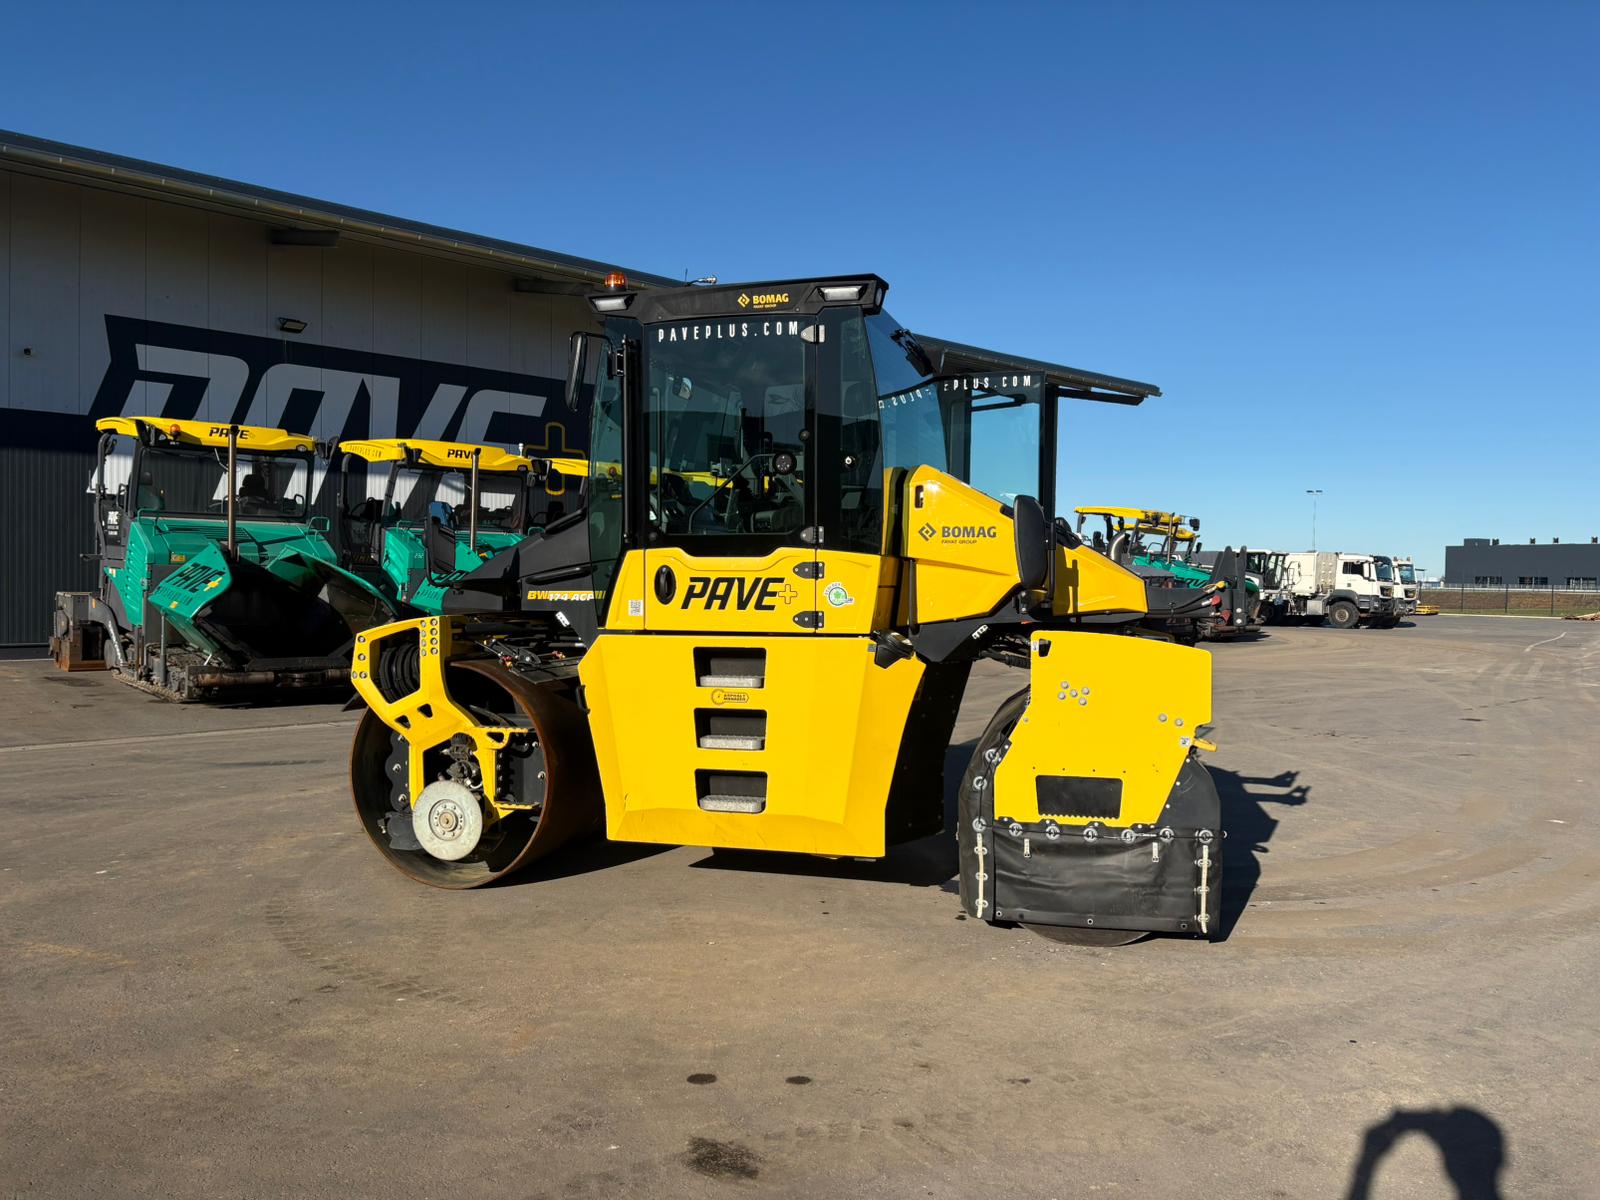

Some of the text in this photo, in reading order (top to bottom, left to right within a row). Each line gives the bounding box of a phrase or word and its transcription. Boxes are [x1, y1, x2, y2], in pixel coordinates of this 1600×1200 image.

[752, 293, 789, 304] BOMAG
[658, 321, 798, 343] PAVEPLUS.COM
[447, 448, 473, 460] PAV
[942, 526, 997, 538] BOMAG
